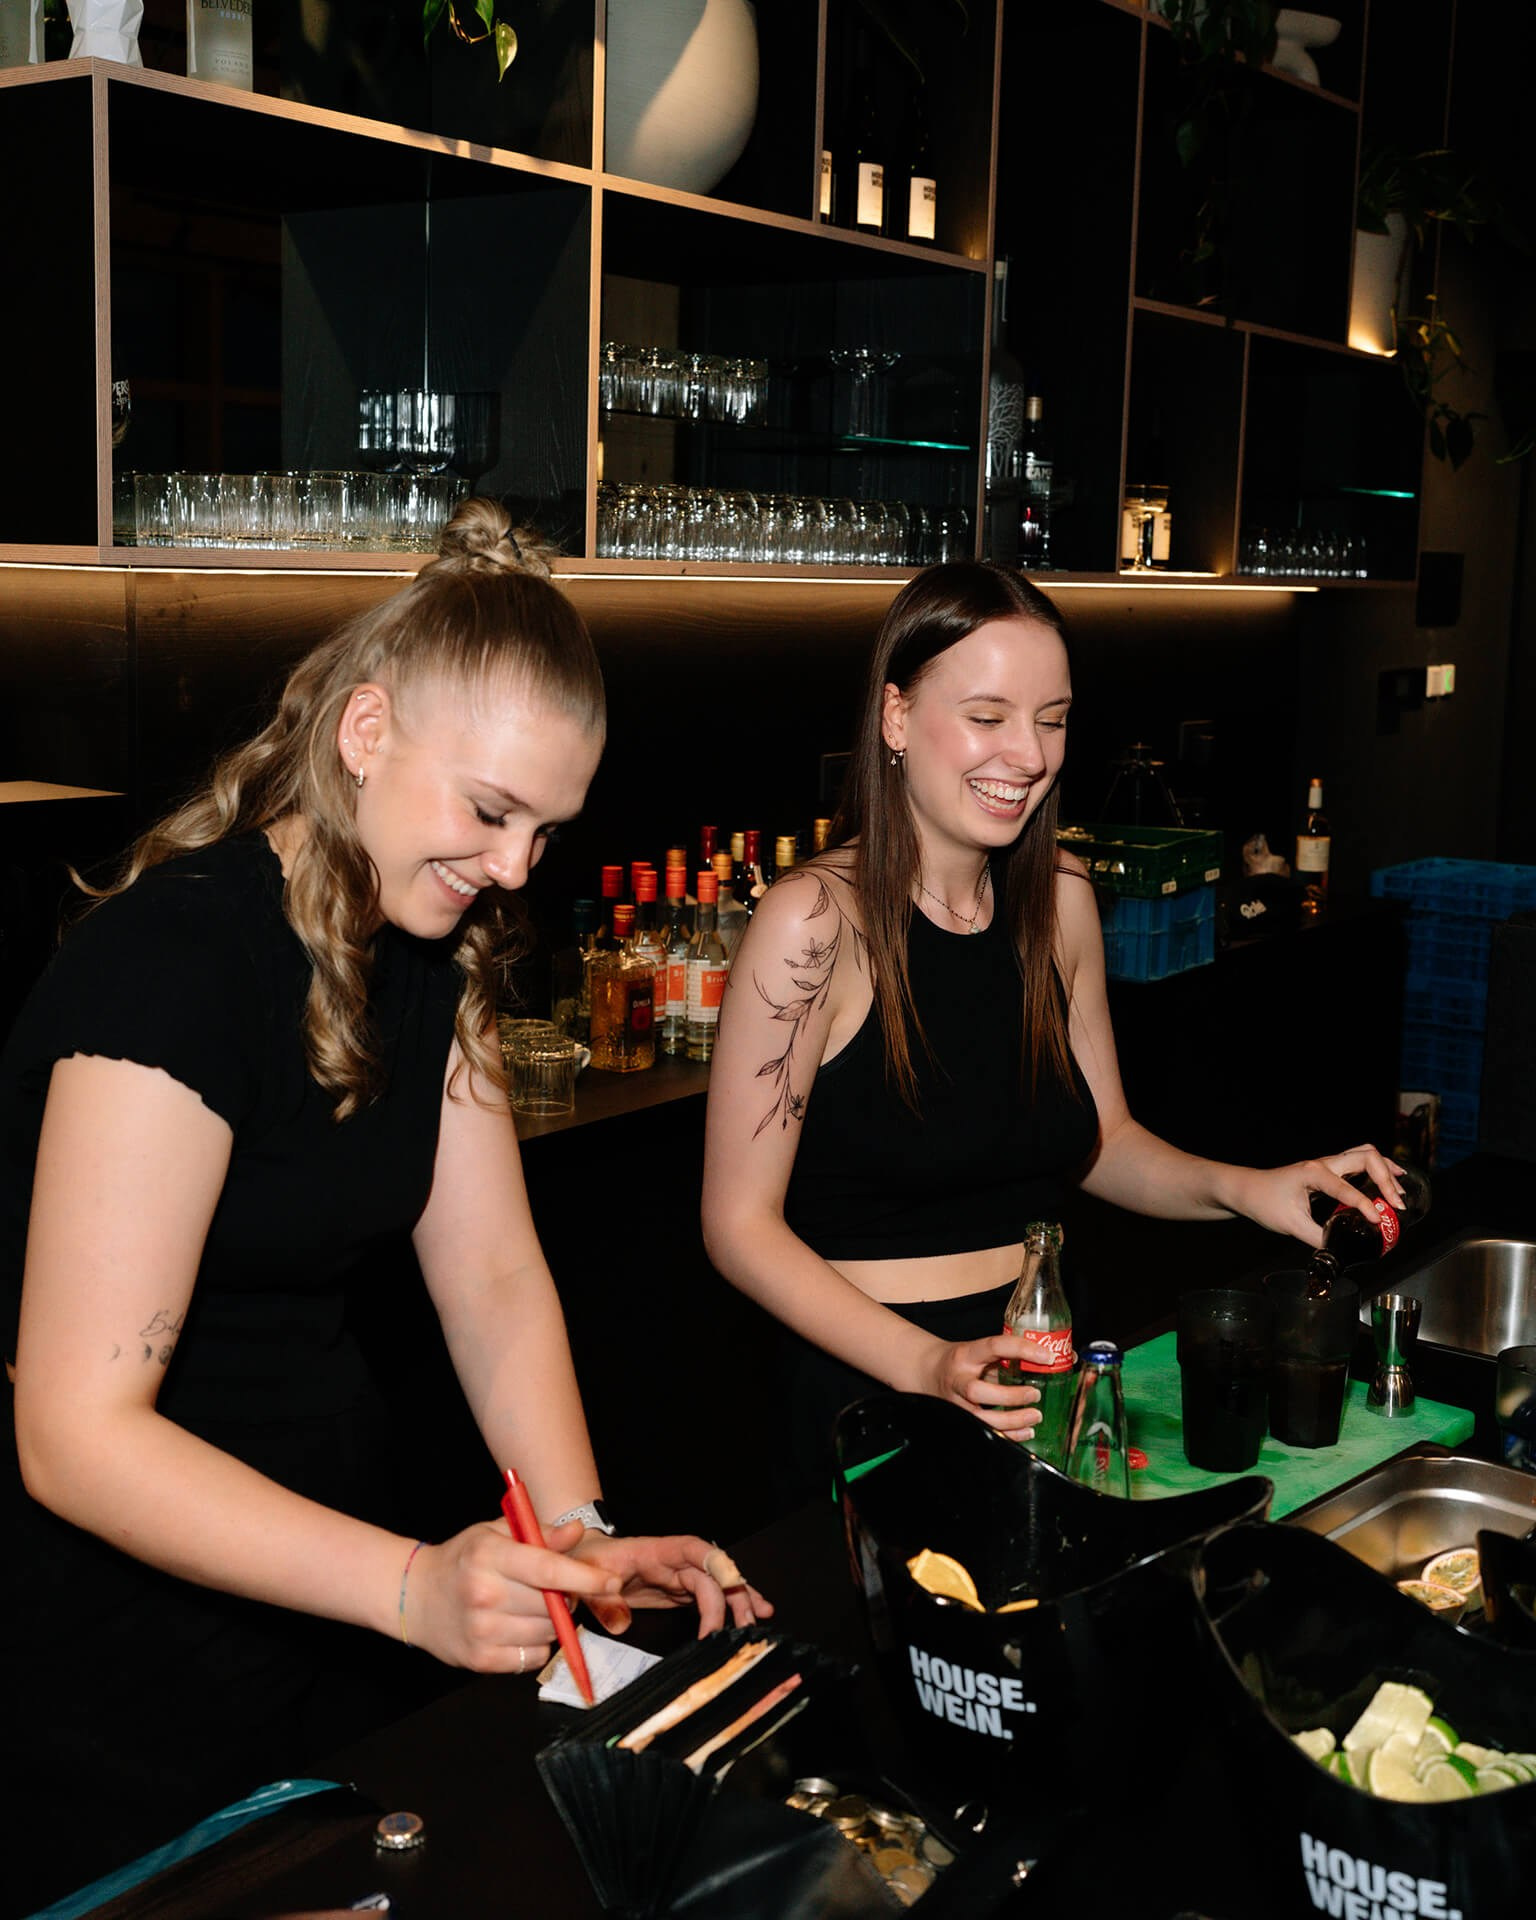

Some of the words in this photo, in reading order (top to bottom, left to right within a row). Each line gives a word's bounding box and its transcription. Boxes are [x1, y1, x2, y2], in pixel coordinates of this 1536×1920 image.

[908, 1644, 1037, 1713] HOUSE.
[914, 1677, 1014, 1741] WEIN.
[1300, 1831, 1463, 1920] HOUSE.
